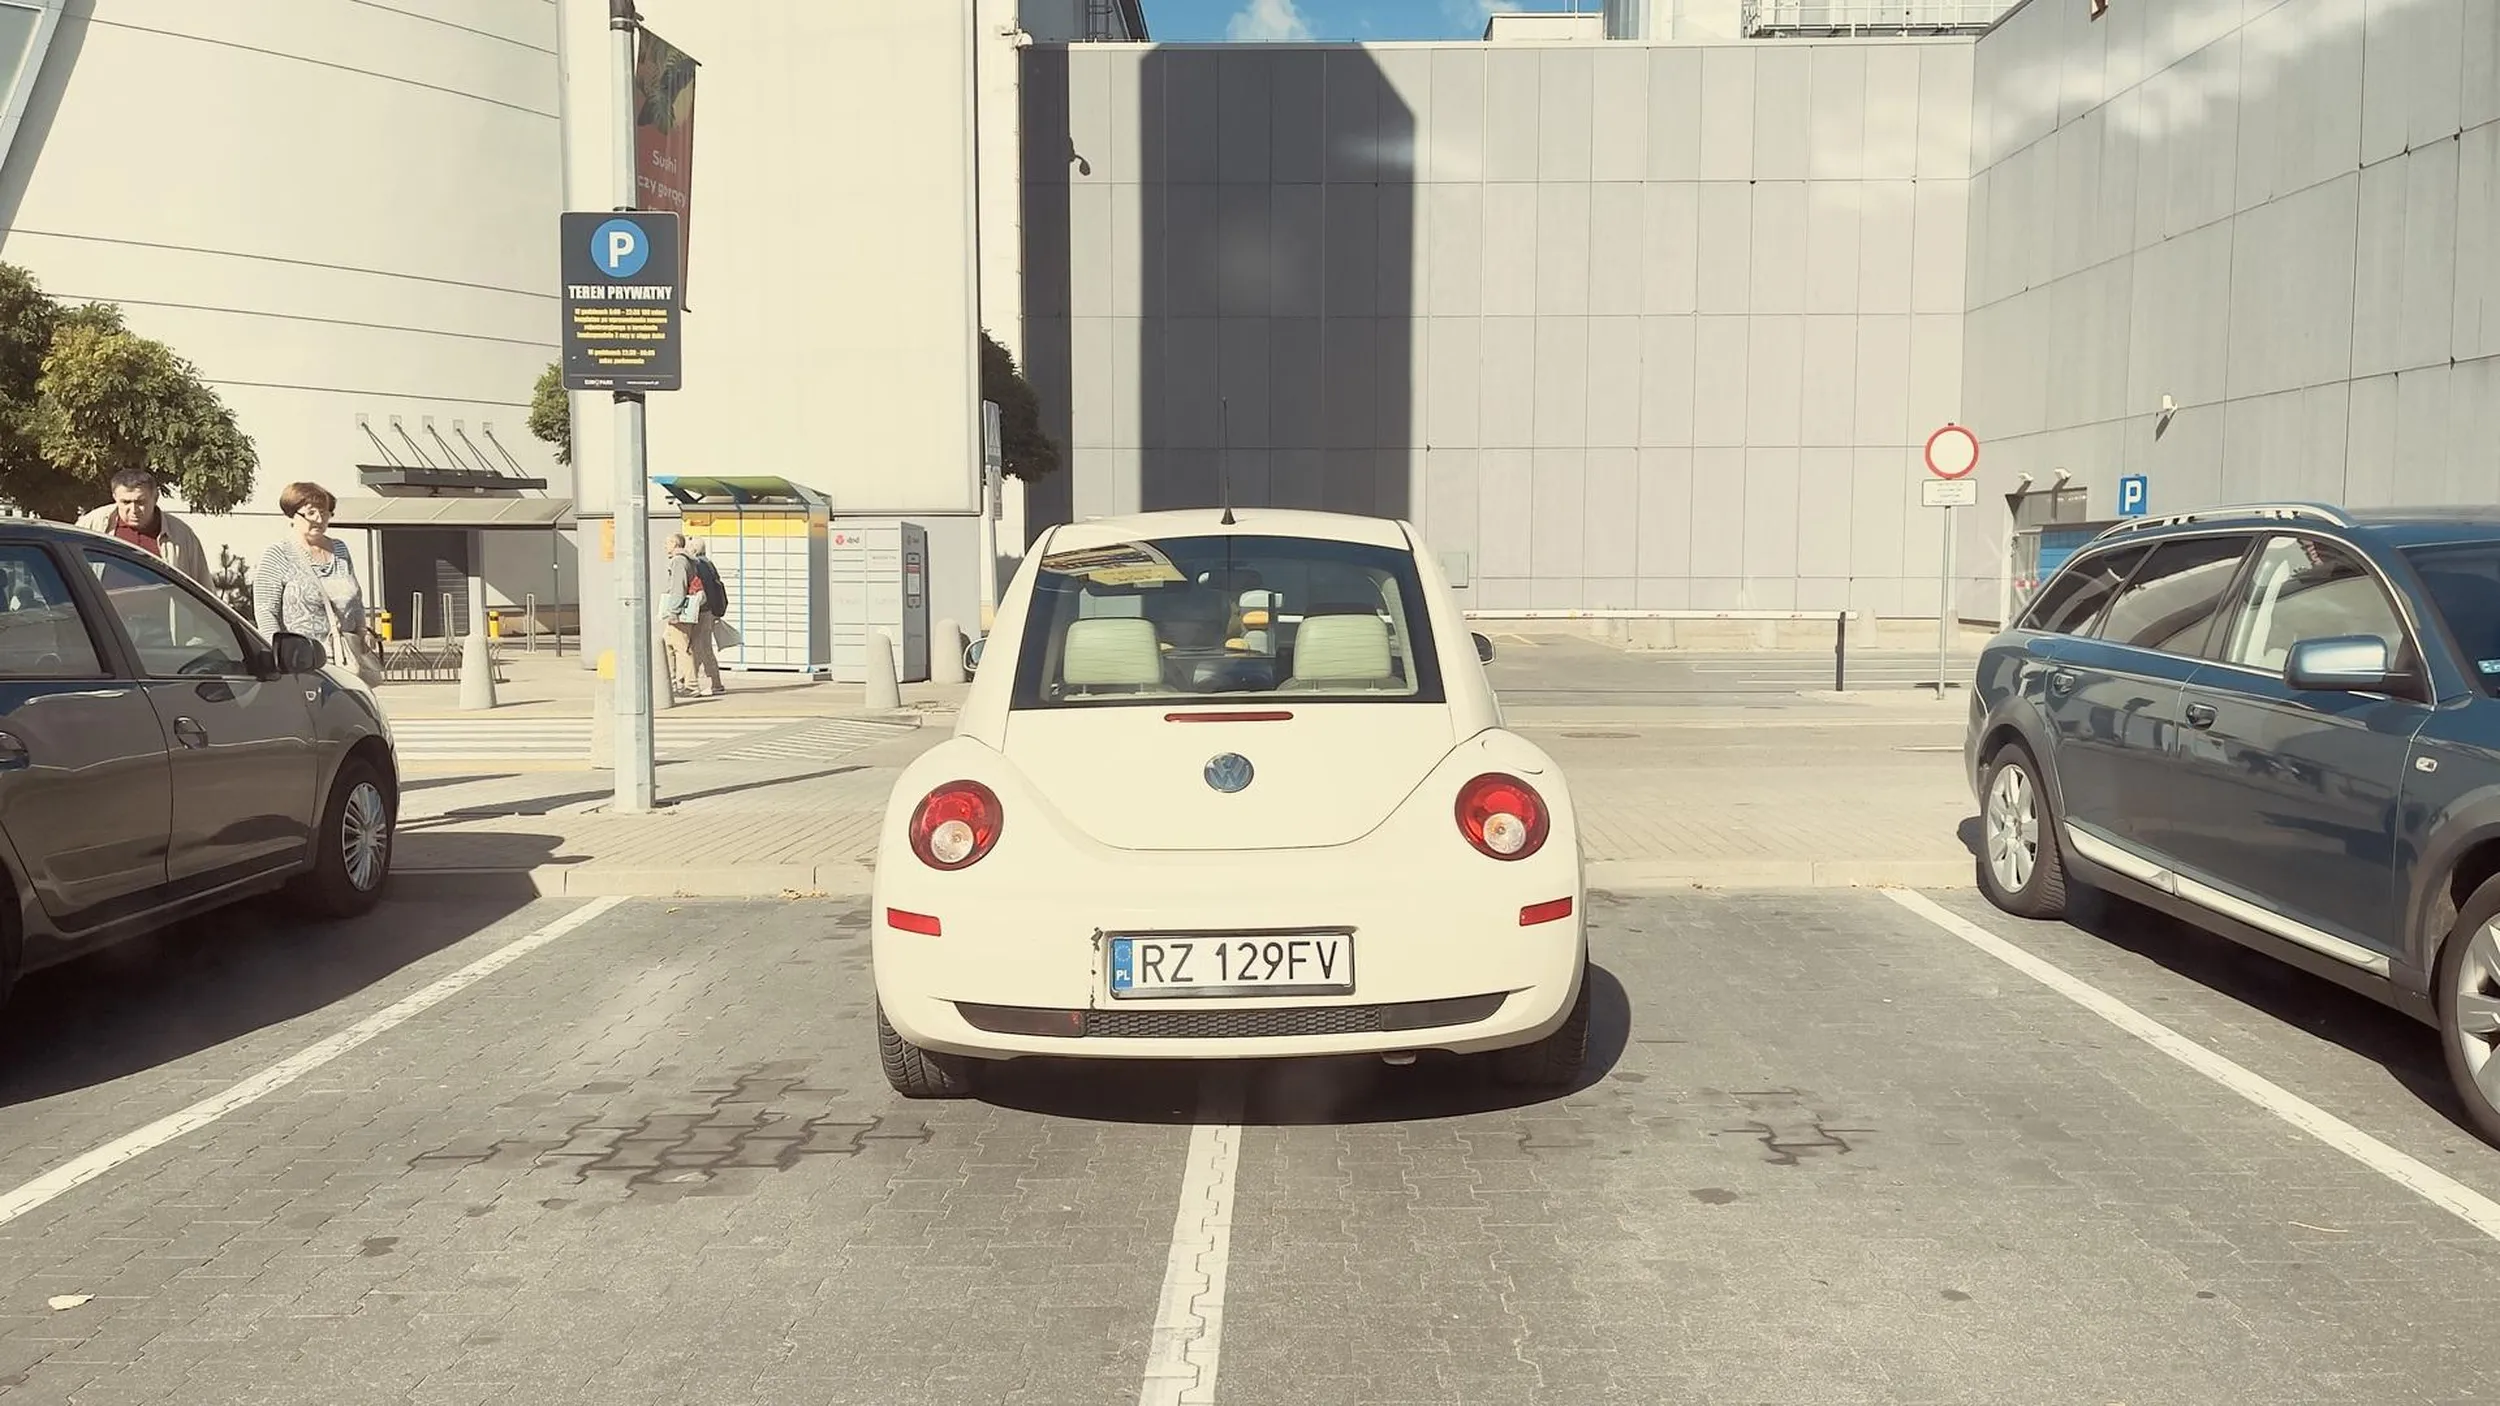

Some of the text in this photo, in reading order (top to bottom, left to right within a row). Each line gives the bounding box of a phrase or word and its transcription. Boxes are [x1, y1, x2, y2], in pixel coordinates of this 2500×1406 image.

[652, 150, 677, 175] Sushi
[638, 175, 657, 195] czy
[608, 231, 635, 268] P
[568, 285, 673, 300] TEREN PRYWATNY
[2125, 480, 2142, 512] P
[1142, 940, 1338, 983] RZ 129FV
[1116, 969, 1131, 981] PL
